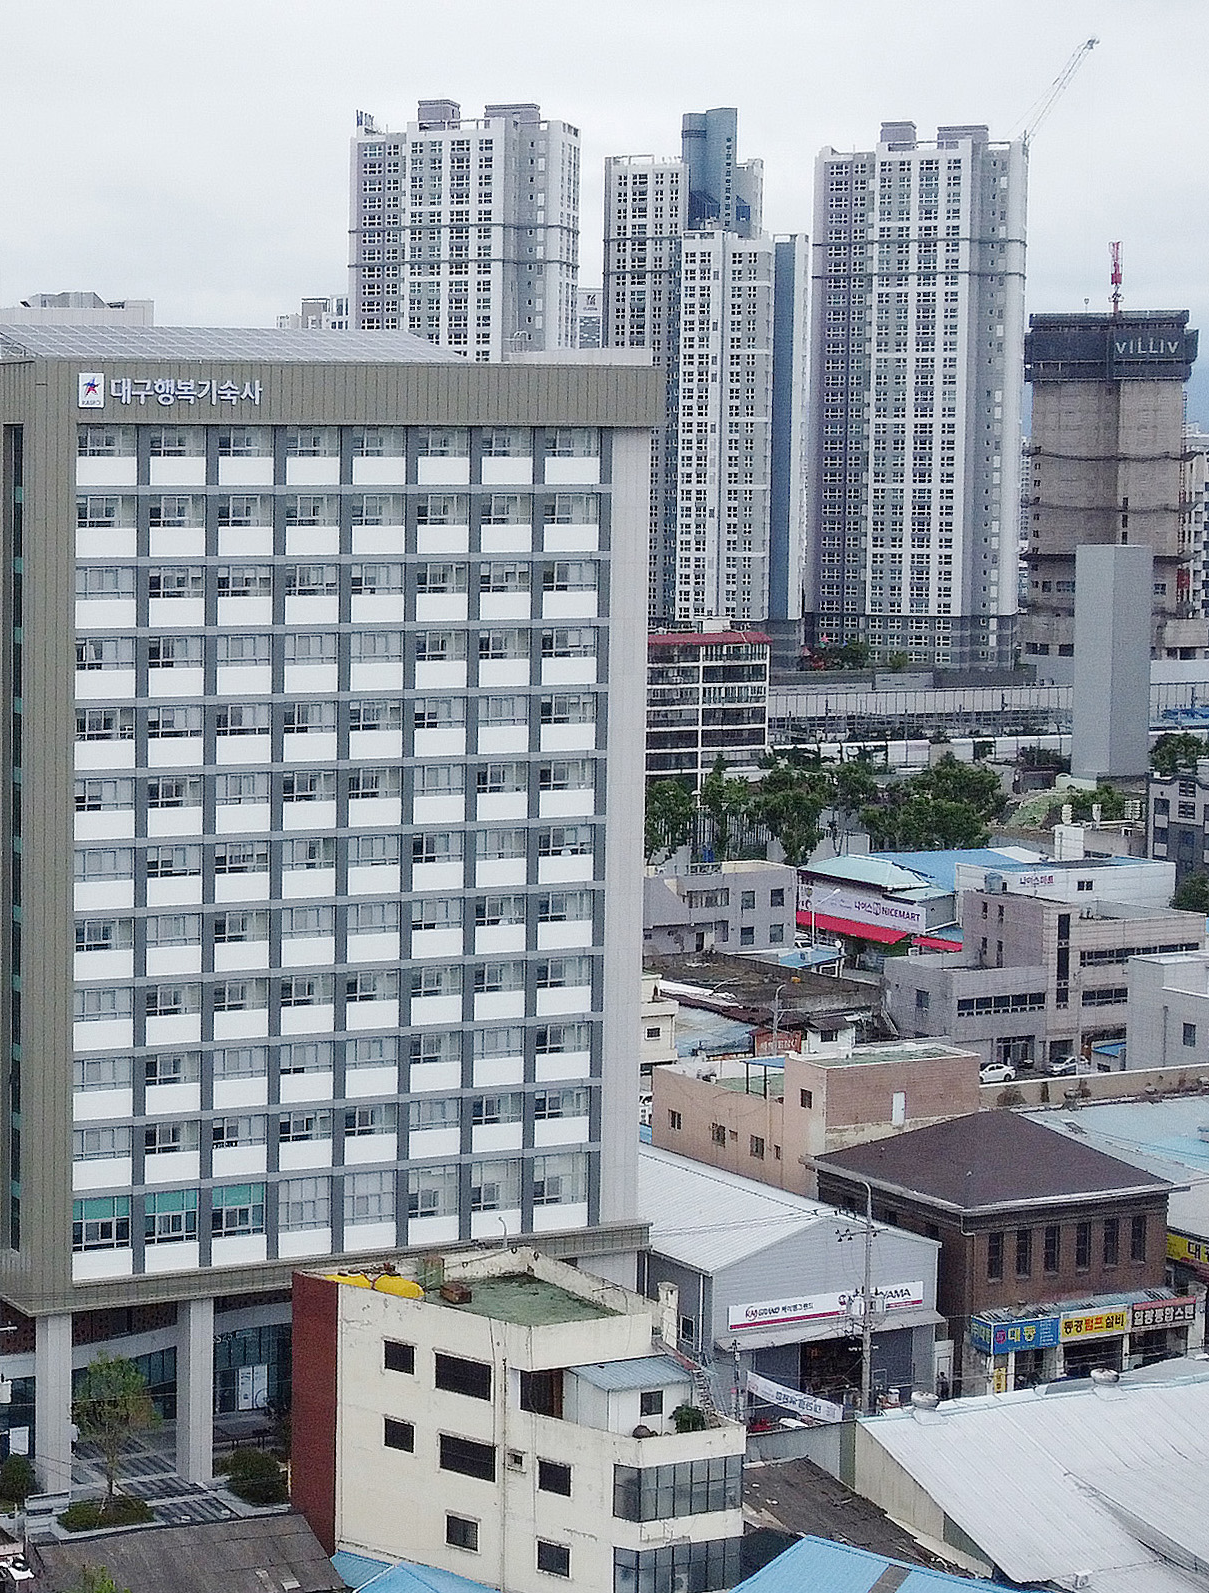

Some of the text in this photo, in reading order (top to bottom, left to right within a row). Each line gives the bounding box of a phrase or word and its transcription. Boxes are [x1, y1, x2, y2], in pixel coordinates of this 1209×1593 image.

[1115, 337, 1179, 354] VILLIV
[110, 378, 264, 406] 대구행복기숙사
[882, 906, 921, 923] NICEMART
